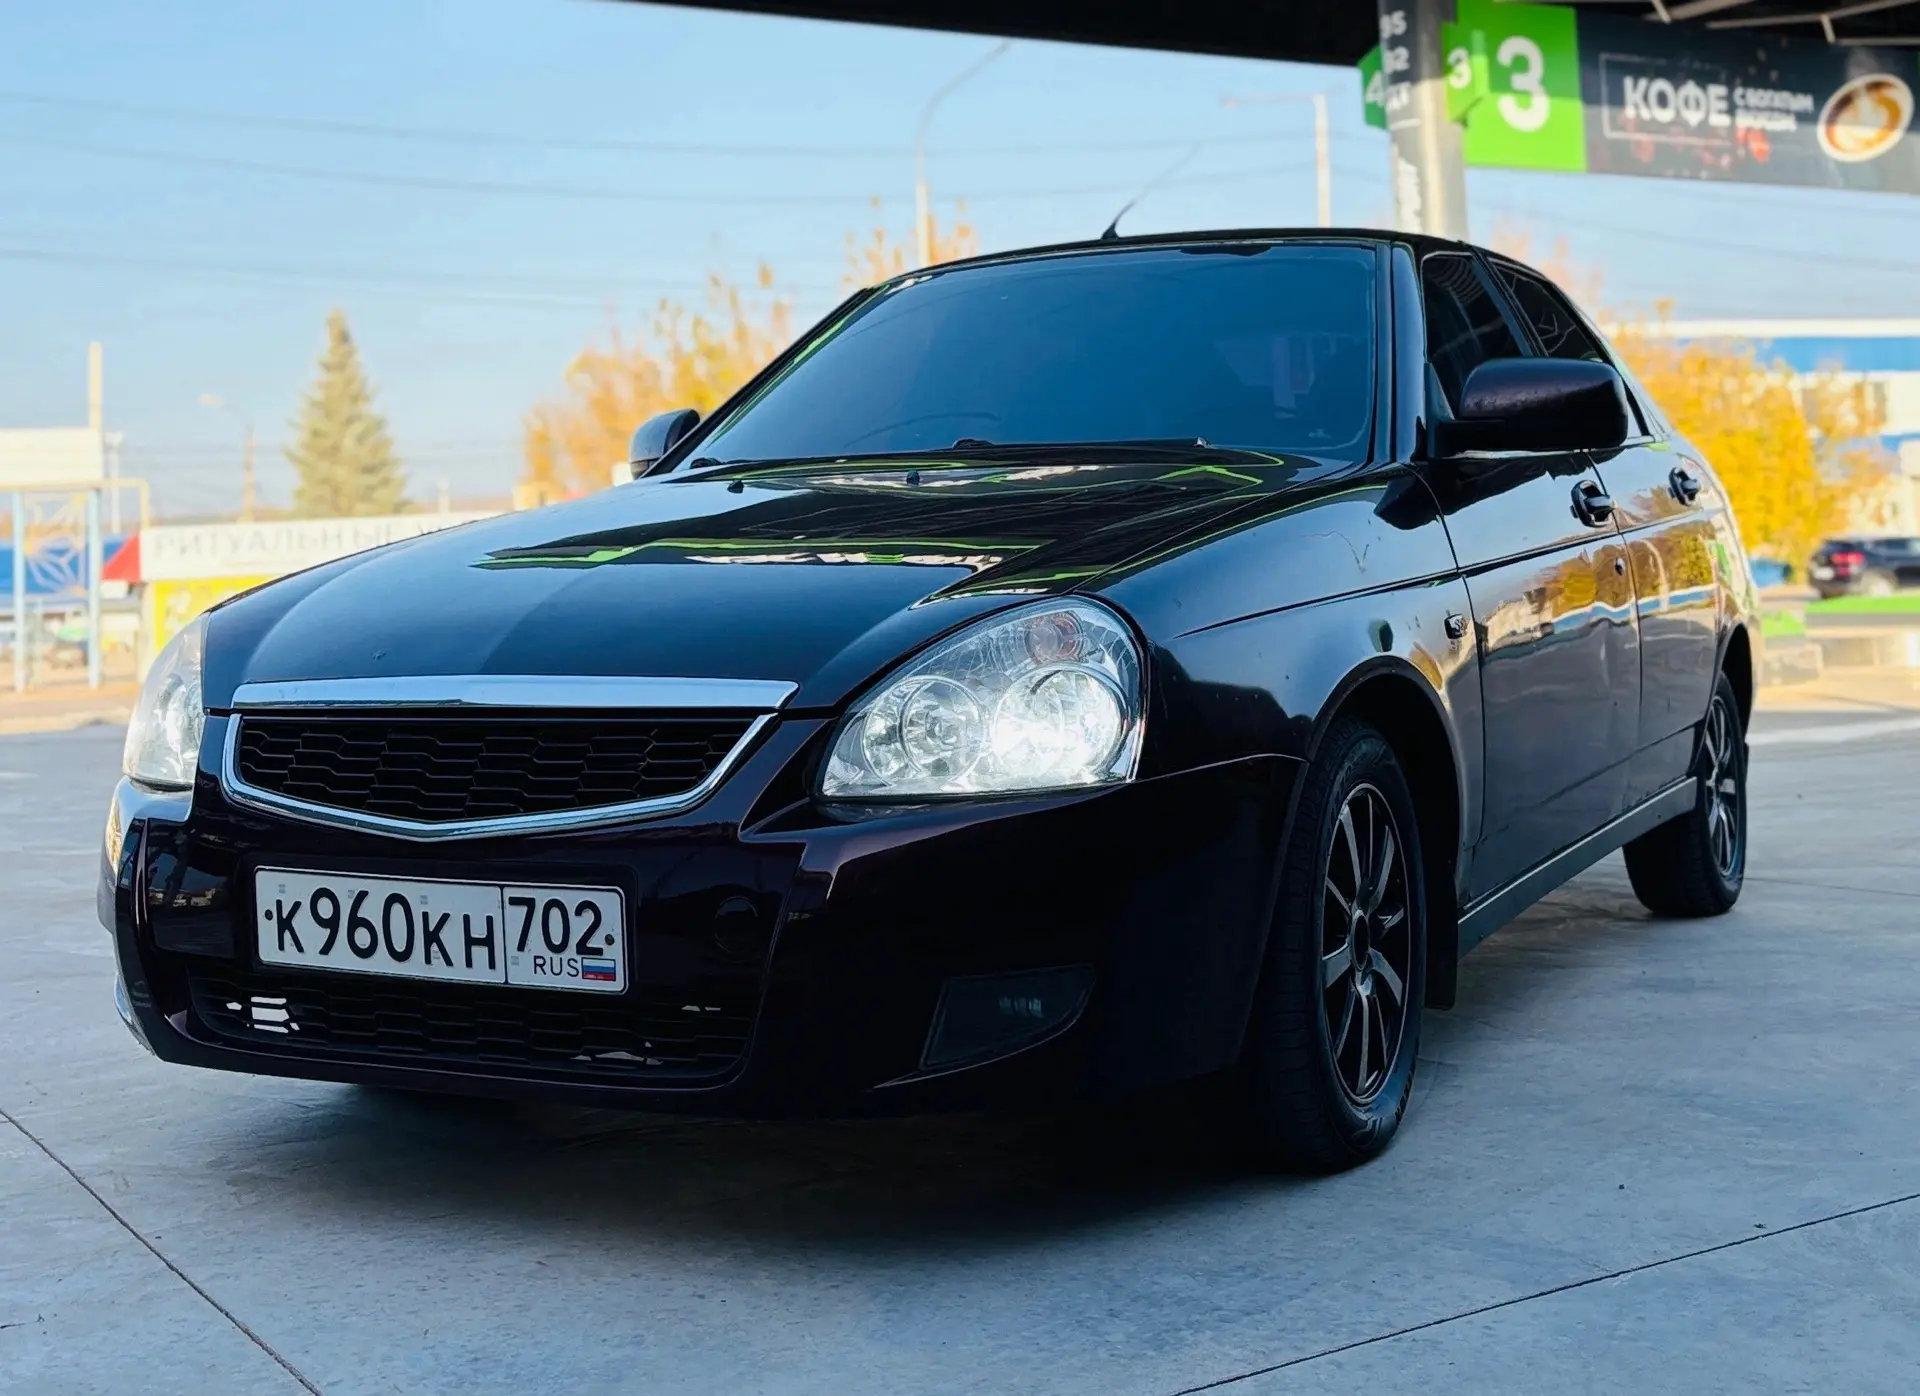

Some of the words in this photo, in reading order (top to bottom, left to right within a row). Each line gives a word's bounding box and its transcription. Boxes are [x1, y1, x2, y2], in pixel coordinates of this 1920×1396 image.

[1448, 48, 1472, 89] 3
[1497, 35, 1550, 132] 3
[1623, 76, 1731, 127] КОФЕ
[275, 887, 496, 970] К960КН
[508, 896, 604, 956] 702
[533, 955, 579, 977] RUS
